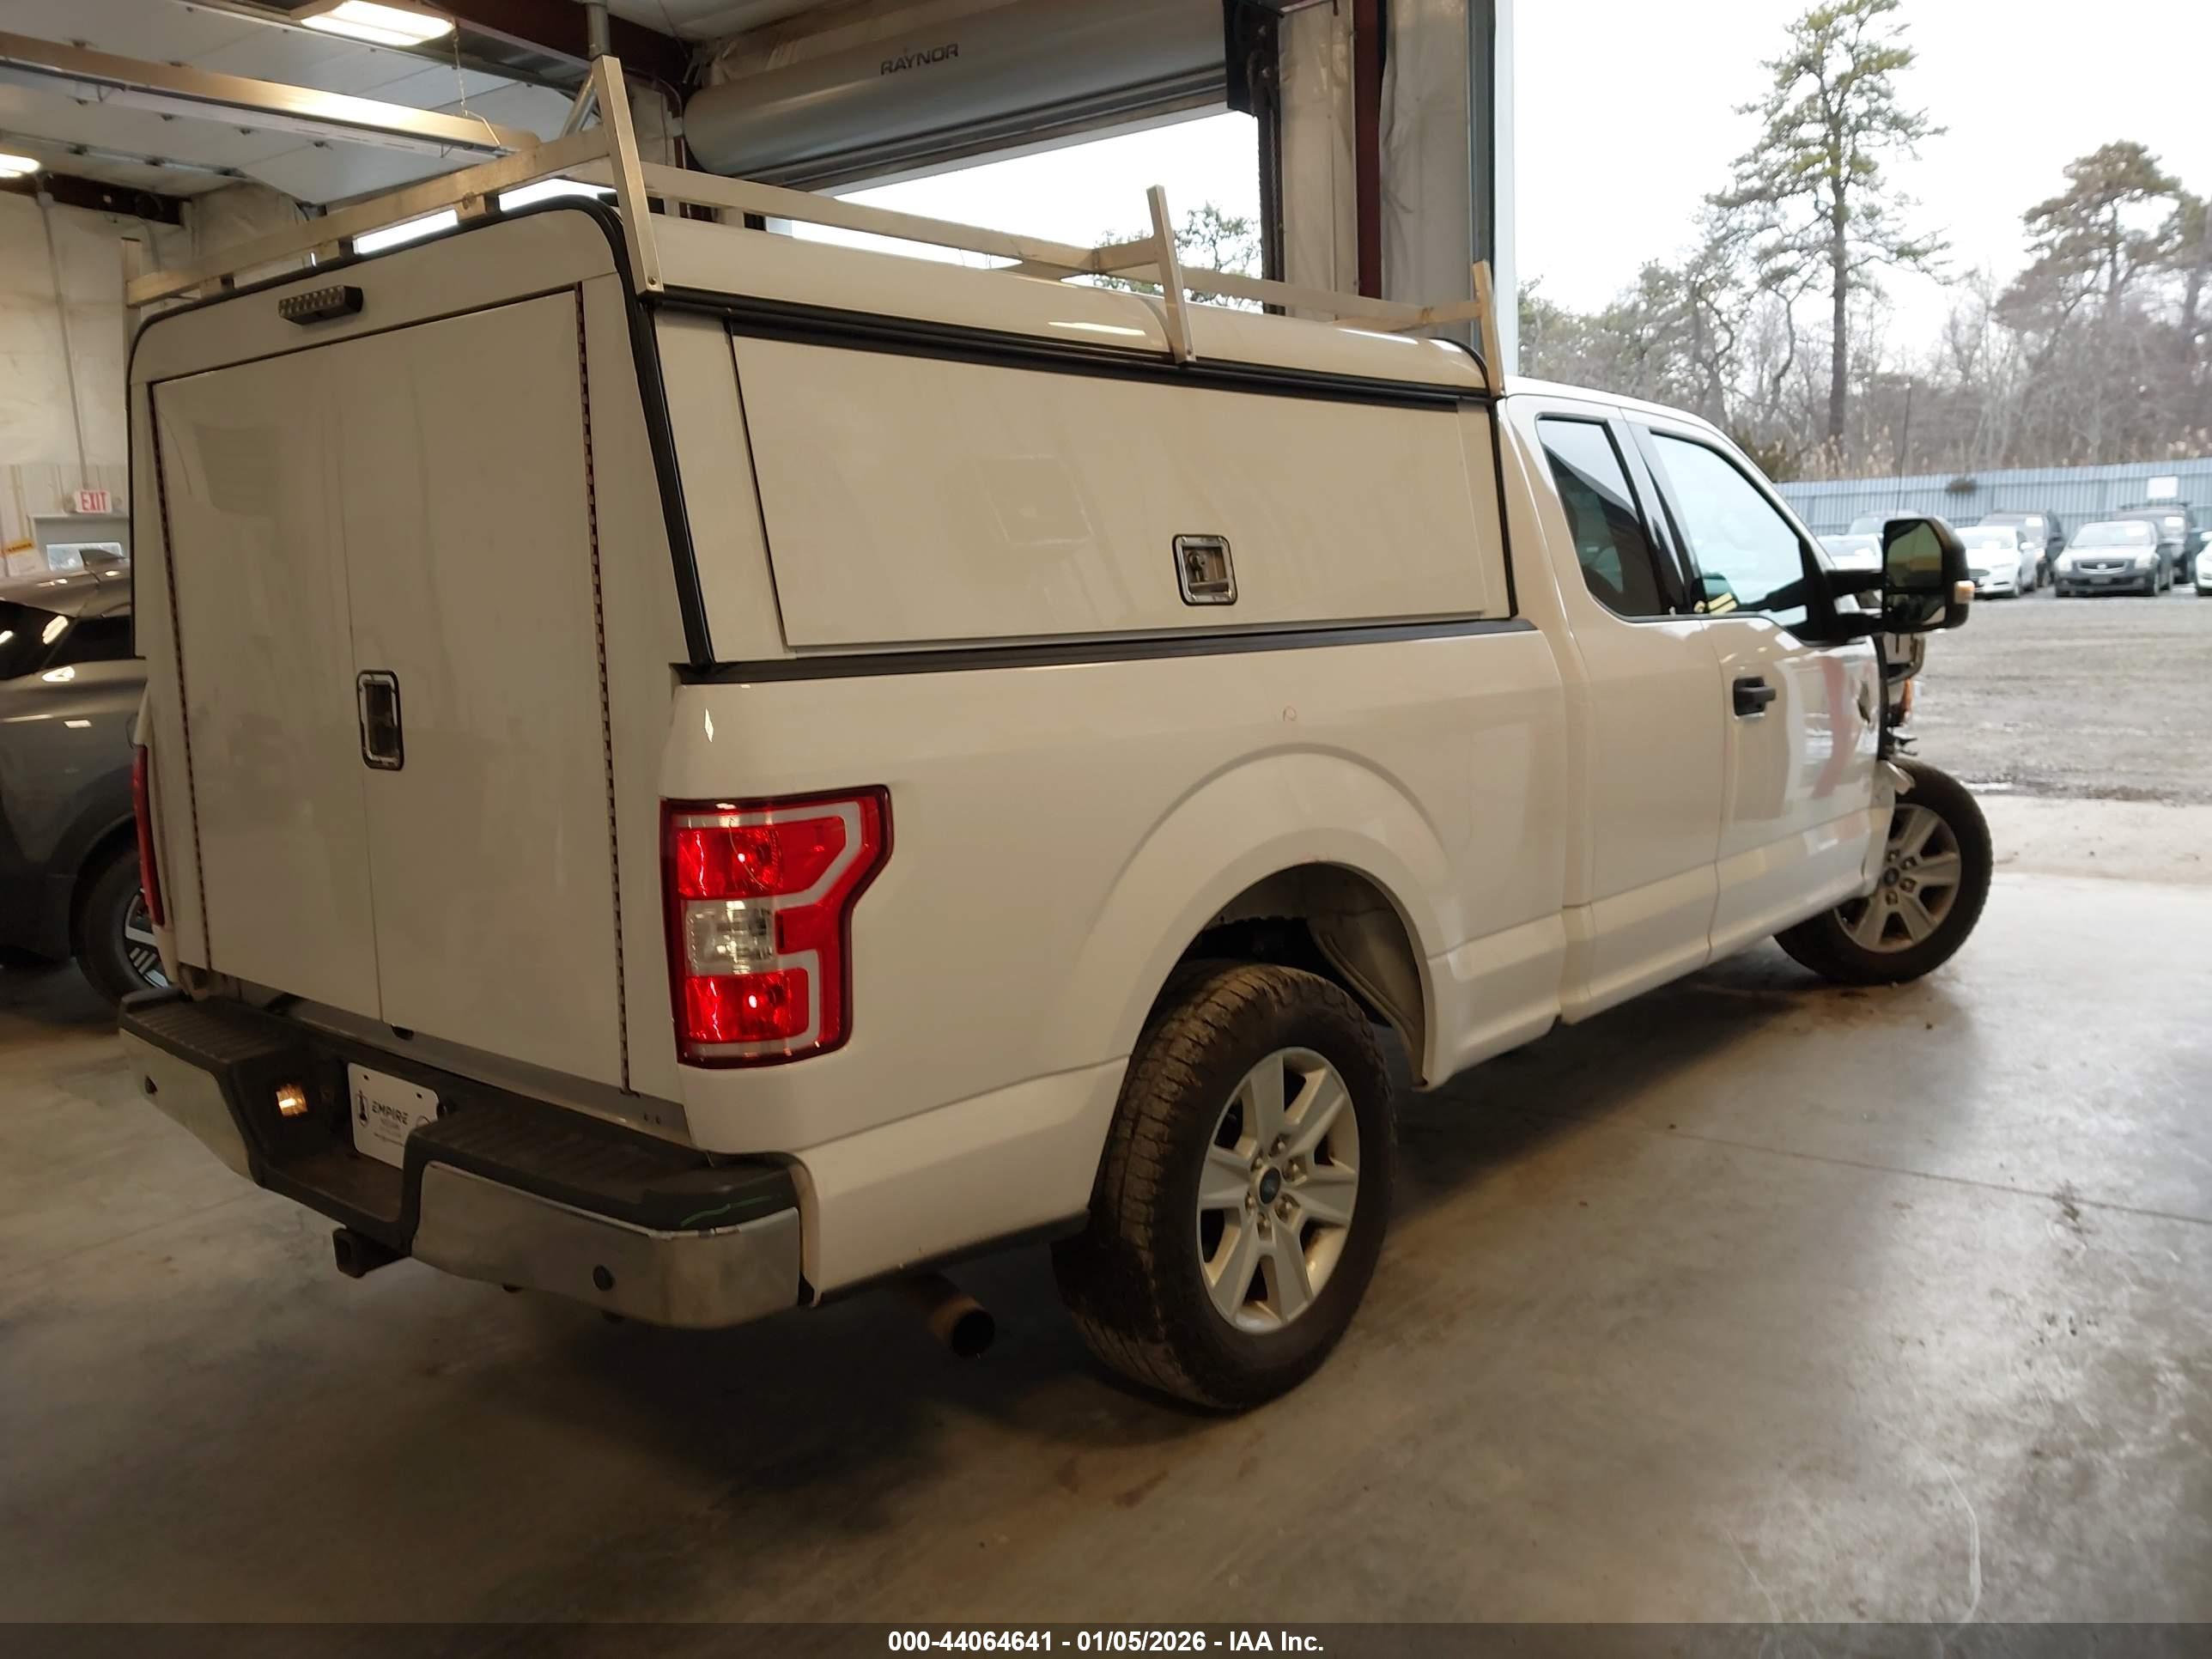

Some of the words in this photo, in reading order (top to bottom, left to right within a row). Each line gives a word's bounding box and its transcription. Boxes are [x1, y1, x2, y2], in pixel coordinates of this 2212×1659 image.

[880, 43, 959, 76] RAYNOR
[82, 491, 106, 511] EXIT
[372, 1101, 409, 1126] EMPIRE
